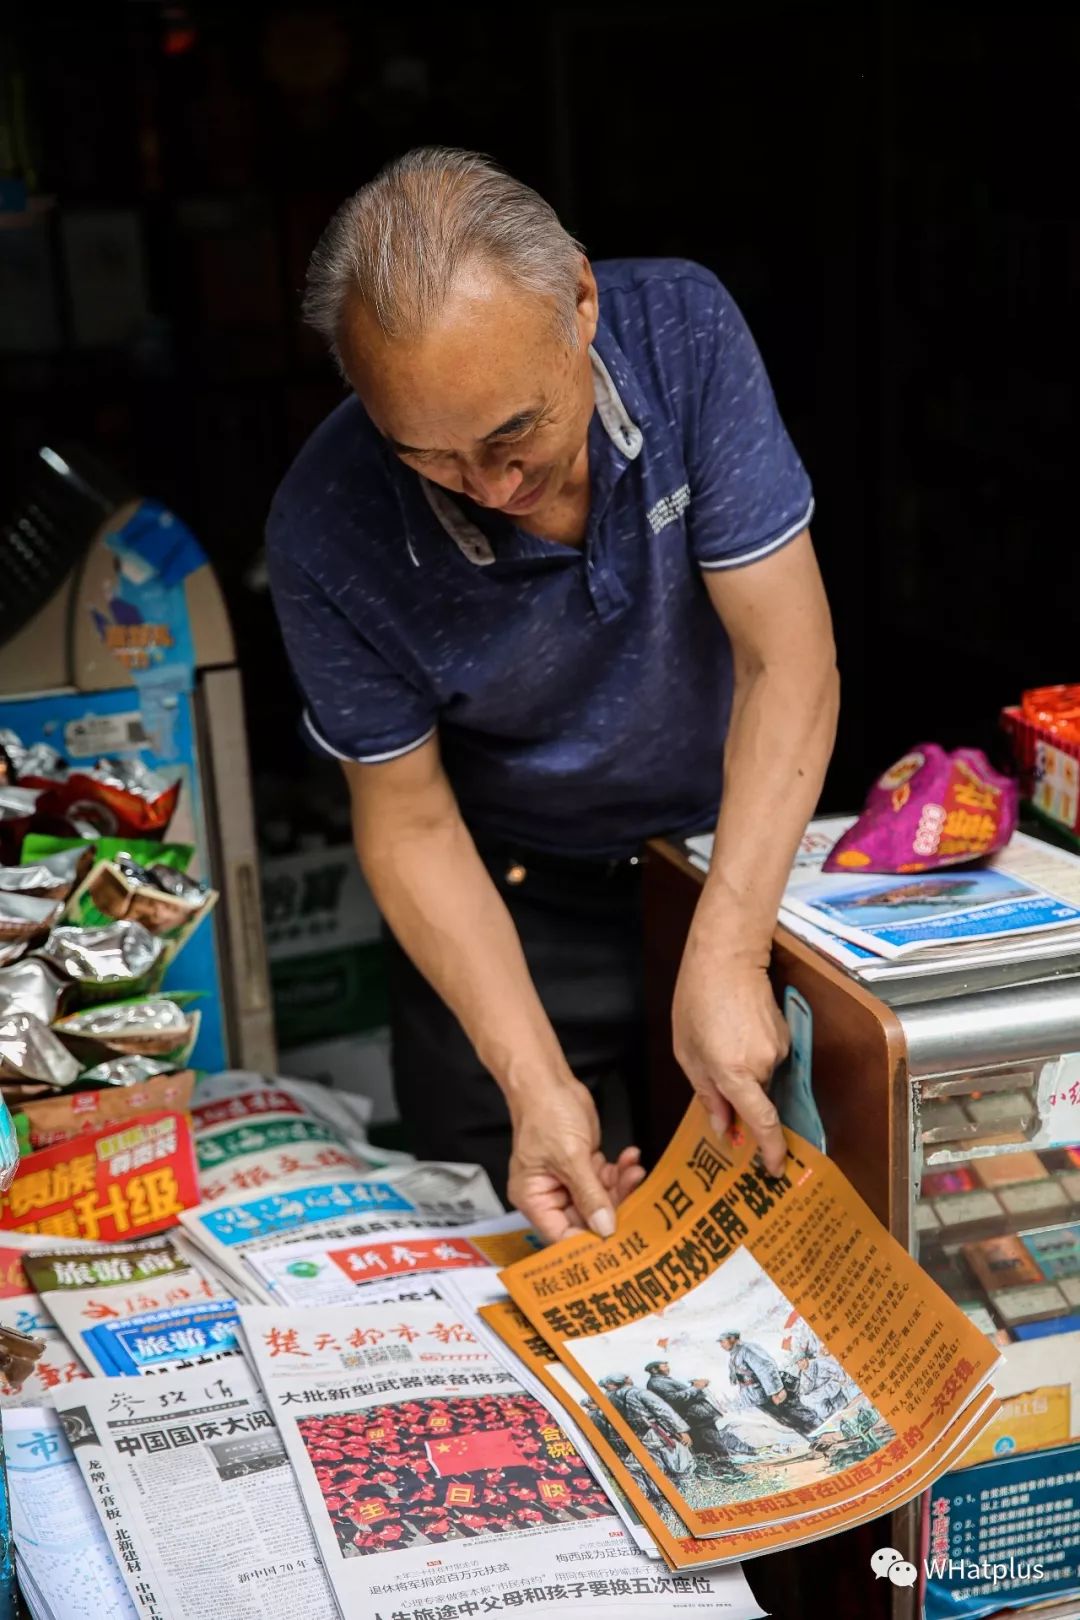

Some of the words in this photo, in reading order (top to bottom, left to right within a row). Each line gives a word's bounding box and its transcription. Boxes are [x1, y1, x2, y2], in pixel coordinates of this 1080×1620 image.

[53, 1250, 190, 1285] 旅游商
[533, 1231, 649, 1297] 旅游商报
[697, 1357, 976, 1525] 邓小平和江青在山西大寨的一次交锋
[556, 1546, 648, 1563] 梅西成为足坛历
